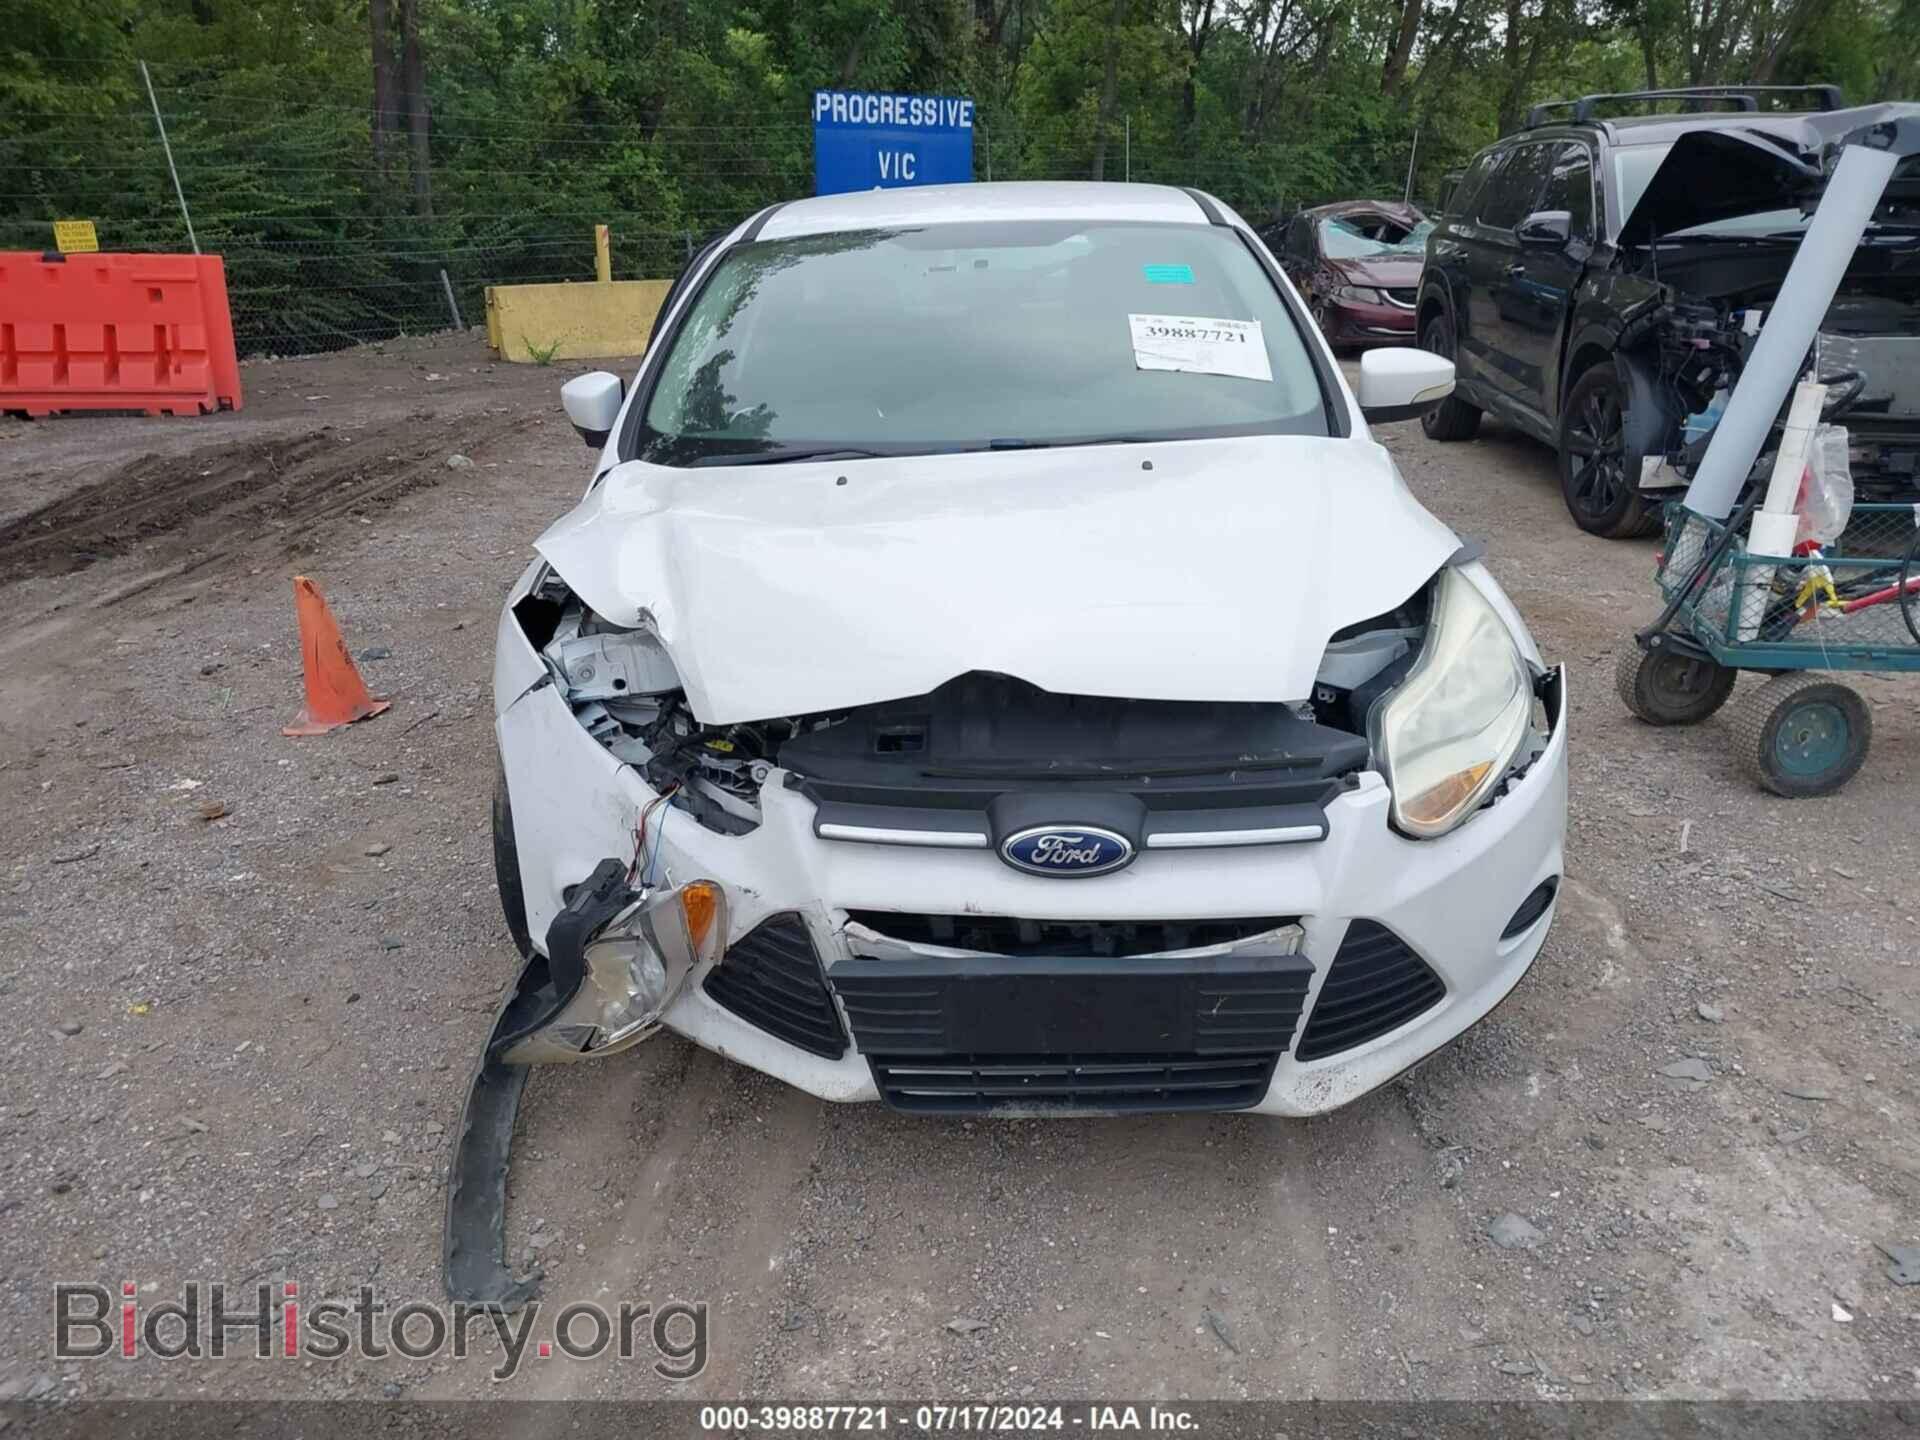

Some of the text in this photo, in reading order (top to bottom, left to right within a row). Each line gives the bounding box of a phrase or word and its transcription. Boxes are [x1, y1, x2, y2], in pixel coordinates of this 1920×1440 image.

[815, 92, 973, 128] PROGRESSIVE
[878, 151, 916, 180] VIC
[1145, 326, 1246, 343] 39887721
[1031, 835, 1101, 864] Ford
